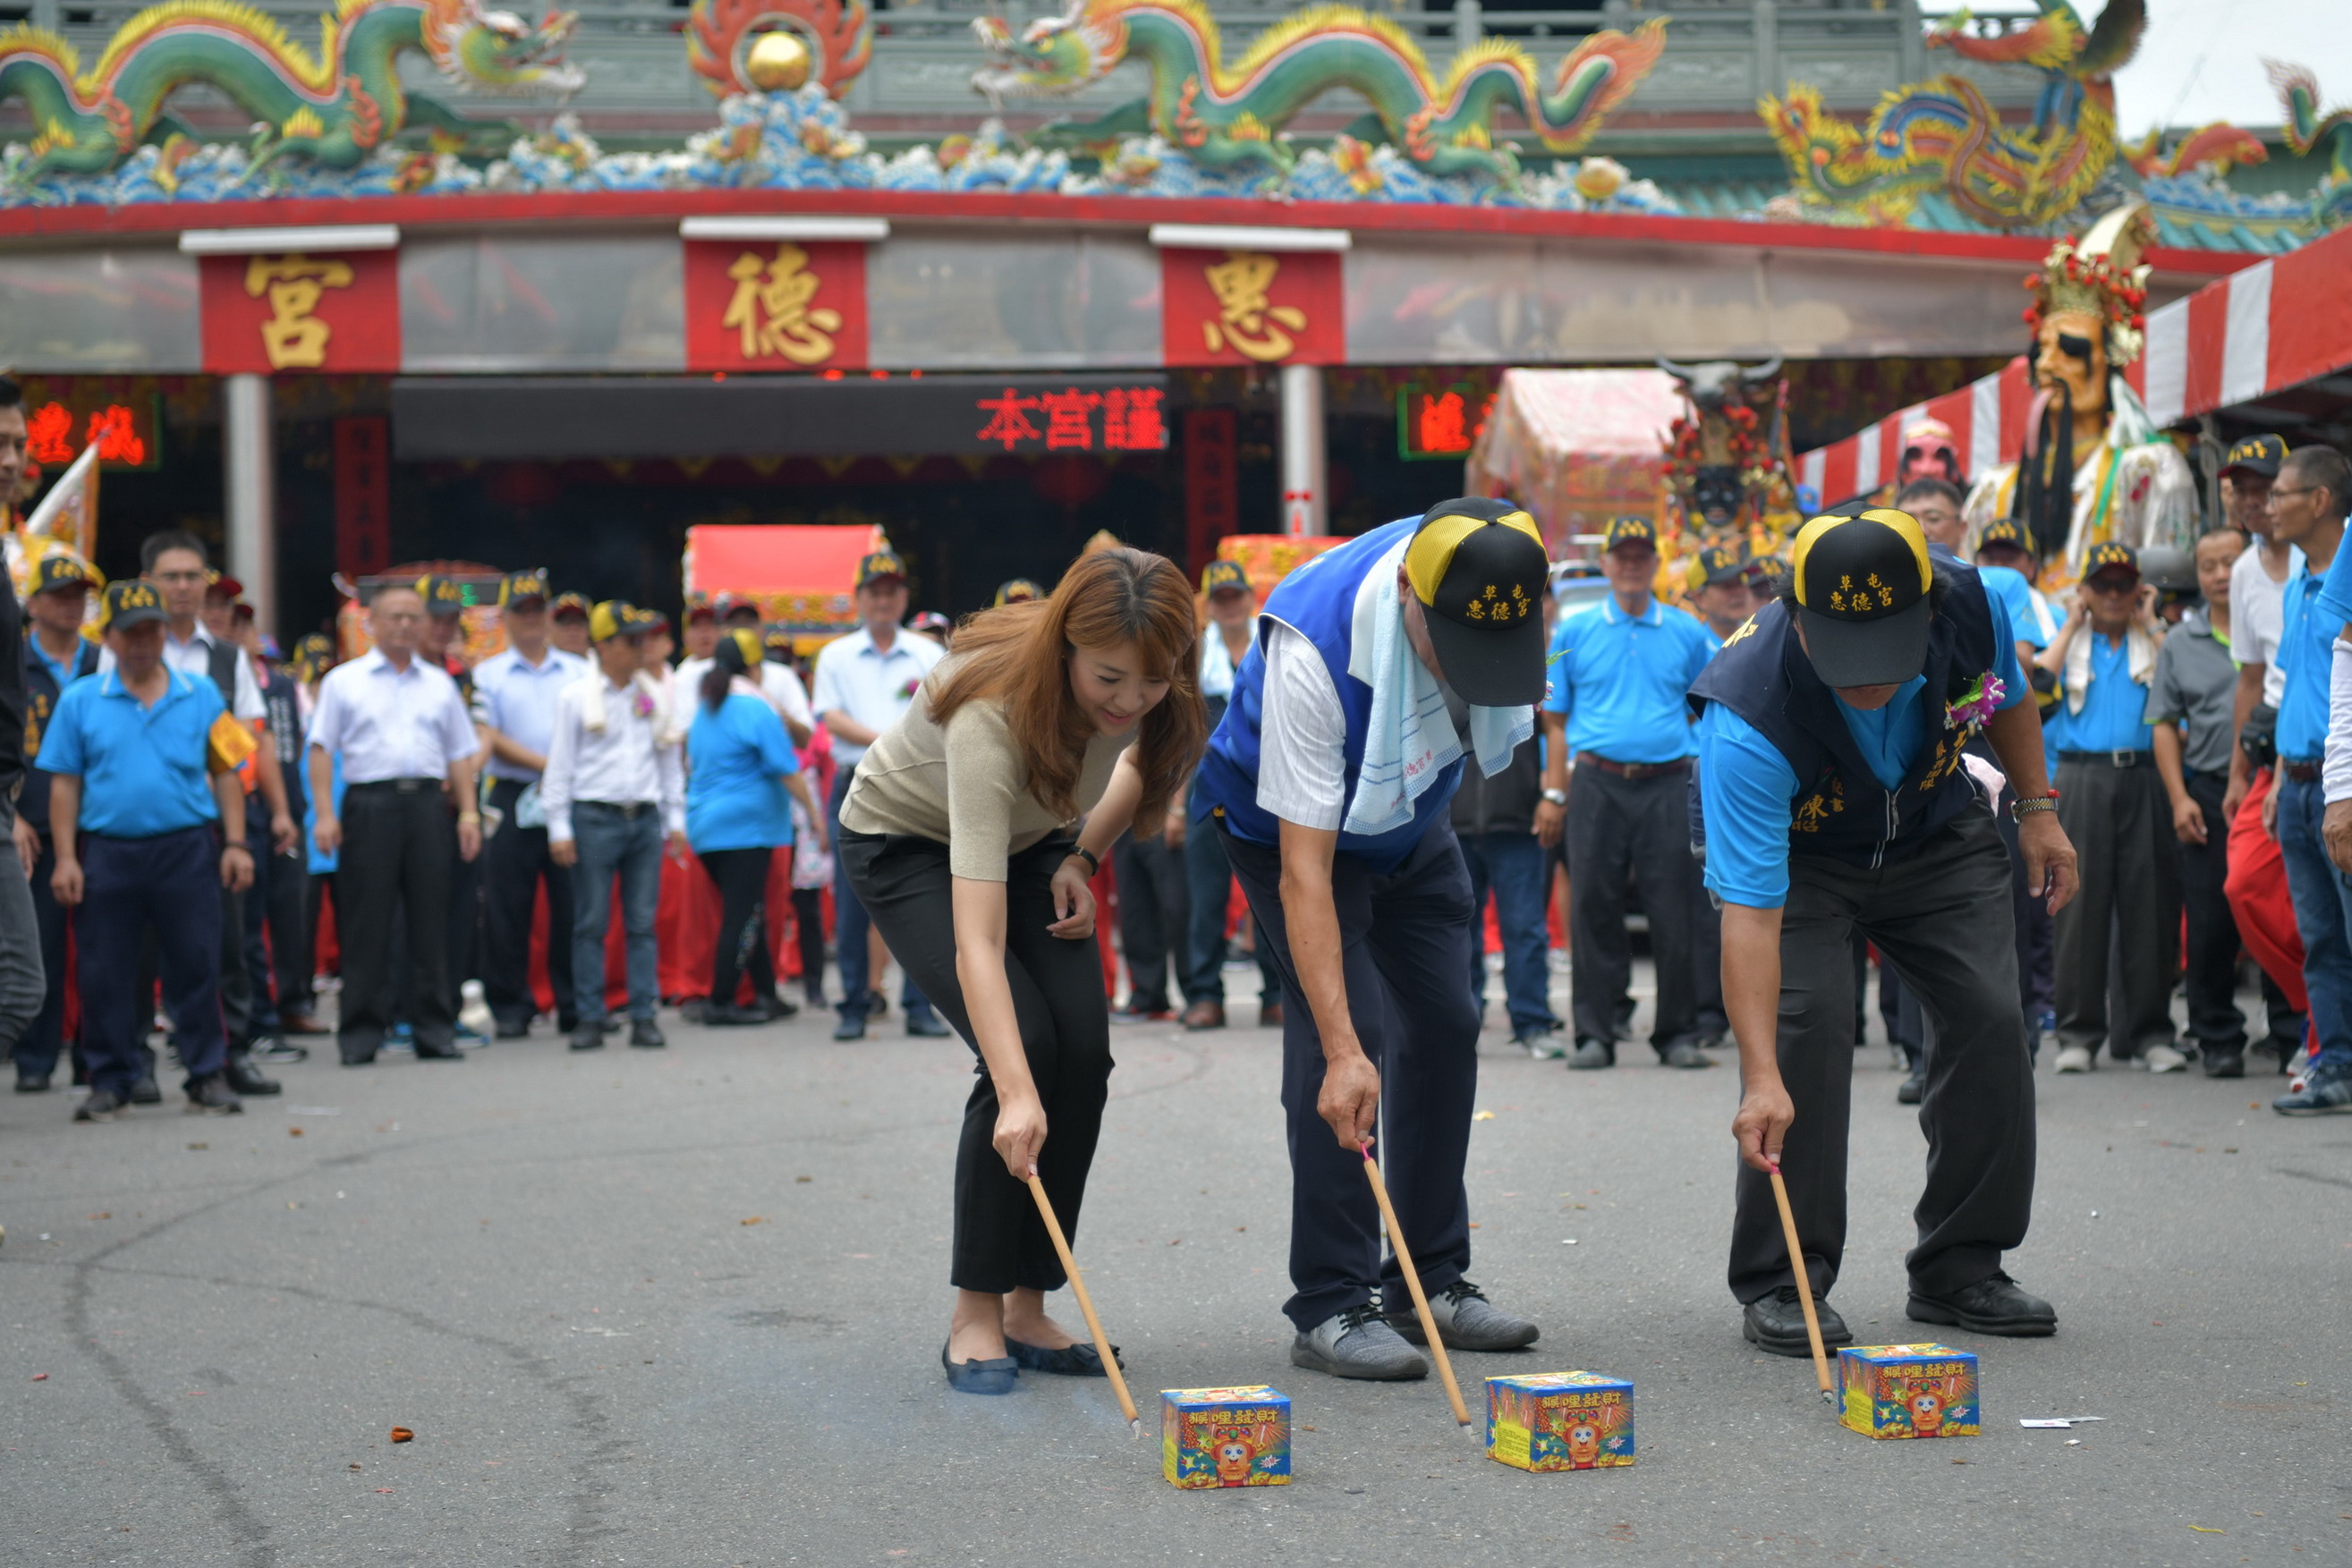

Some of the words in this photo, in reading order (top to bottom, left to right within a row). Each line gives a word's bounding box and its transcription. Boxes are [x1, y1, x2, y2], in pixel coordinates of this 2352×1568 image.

[243, 252, 355, 370] 宮
[721, 243, 844, 366] 德
[976, 386, 1166, 452] 本宮謹
[1482, 584, 1524, 601] 草屯
[1839, 573, 1882, 592] 草屯
[1465, 598, 1532, 621] 惠德宮
[1830, 587, 1894, 612] 惠德宮
[1882, 1363, 1966, 1378] 猴哩發財
[1541, 1392, 1622, 1409] 猴哩發財
[1188, 1410, 1278, 1426] 猴哩發財
